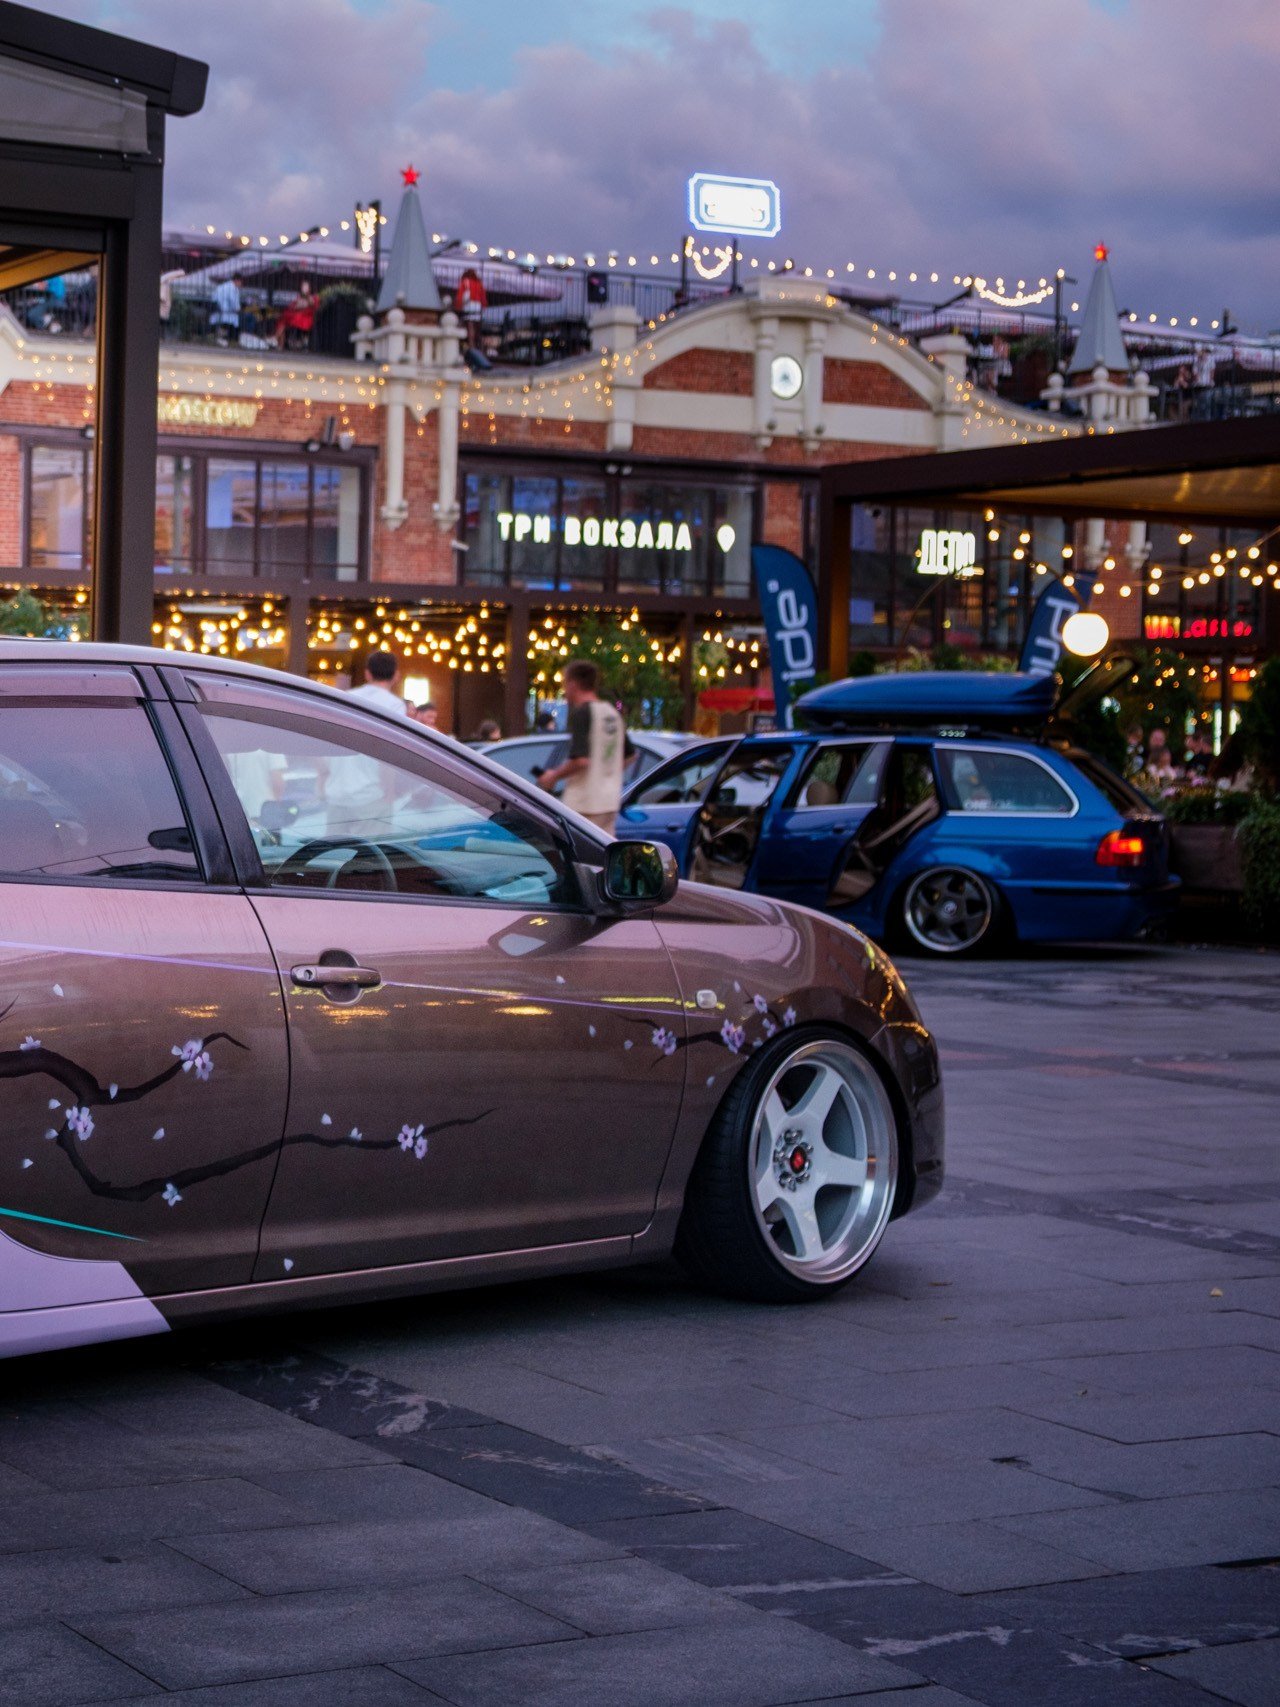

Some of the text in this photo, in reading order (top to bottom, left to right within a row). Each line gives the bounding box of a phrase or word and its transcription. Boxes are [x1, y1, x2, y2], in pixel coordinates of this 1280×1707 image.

[496, 511, 693, 551] ТРИ ВОКЗАЛА
[917, 529, 976, 575] ДЕПО
